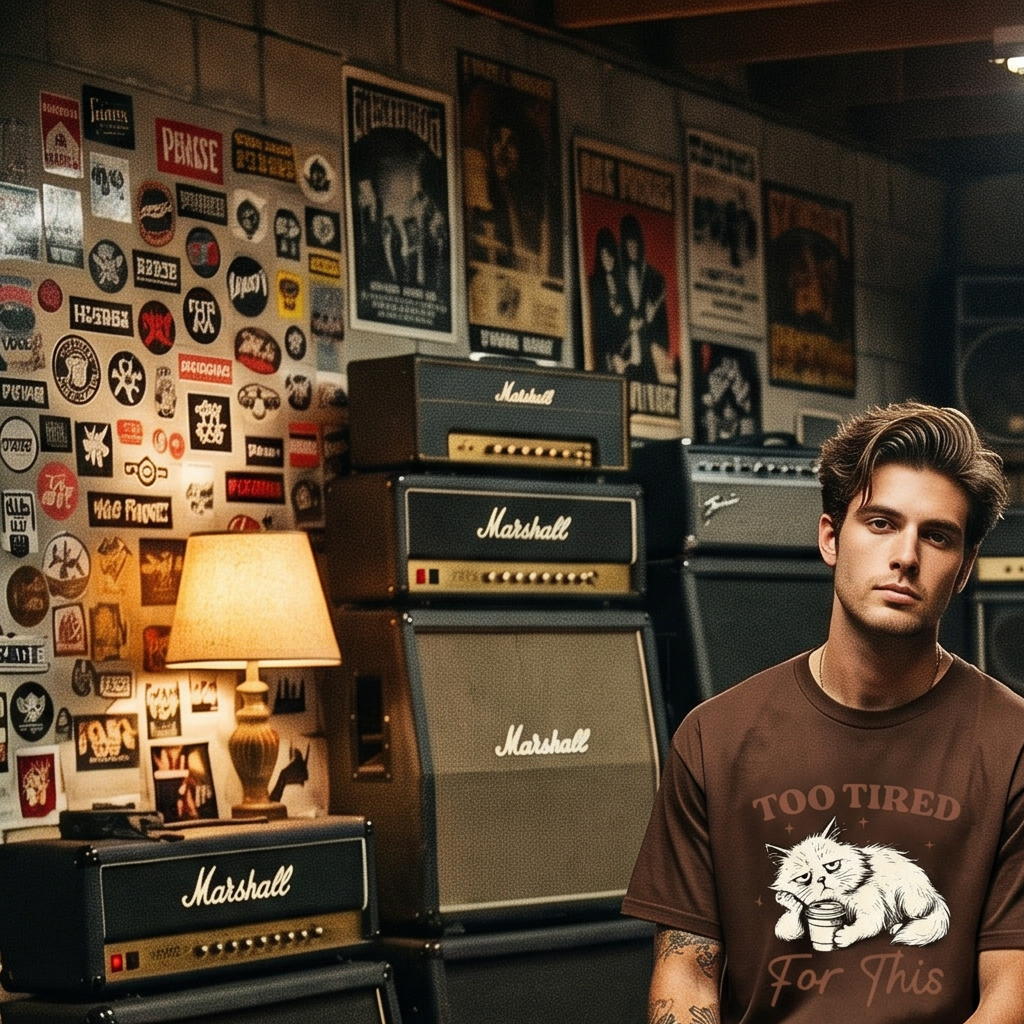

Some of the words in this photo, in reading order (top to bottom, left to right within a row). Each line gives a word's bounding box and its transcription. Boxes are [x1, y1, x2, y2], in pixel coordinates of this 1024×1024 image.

[476, 506, 573, 541] Marshall
[494, 724, 591, 757] Marshall
[752, 784, 836, 822] TOO
[842, 783, 961, 822] TIRED
[181, 864, 295, 909] Marshall
[767, 953, 845, 1008] For
[860, 950, 945, 1008] This
